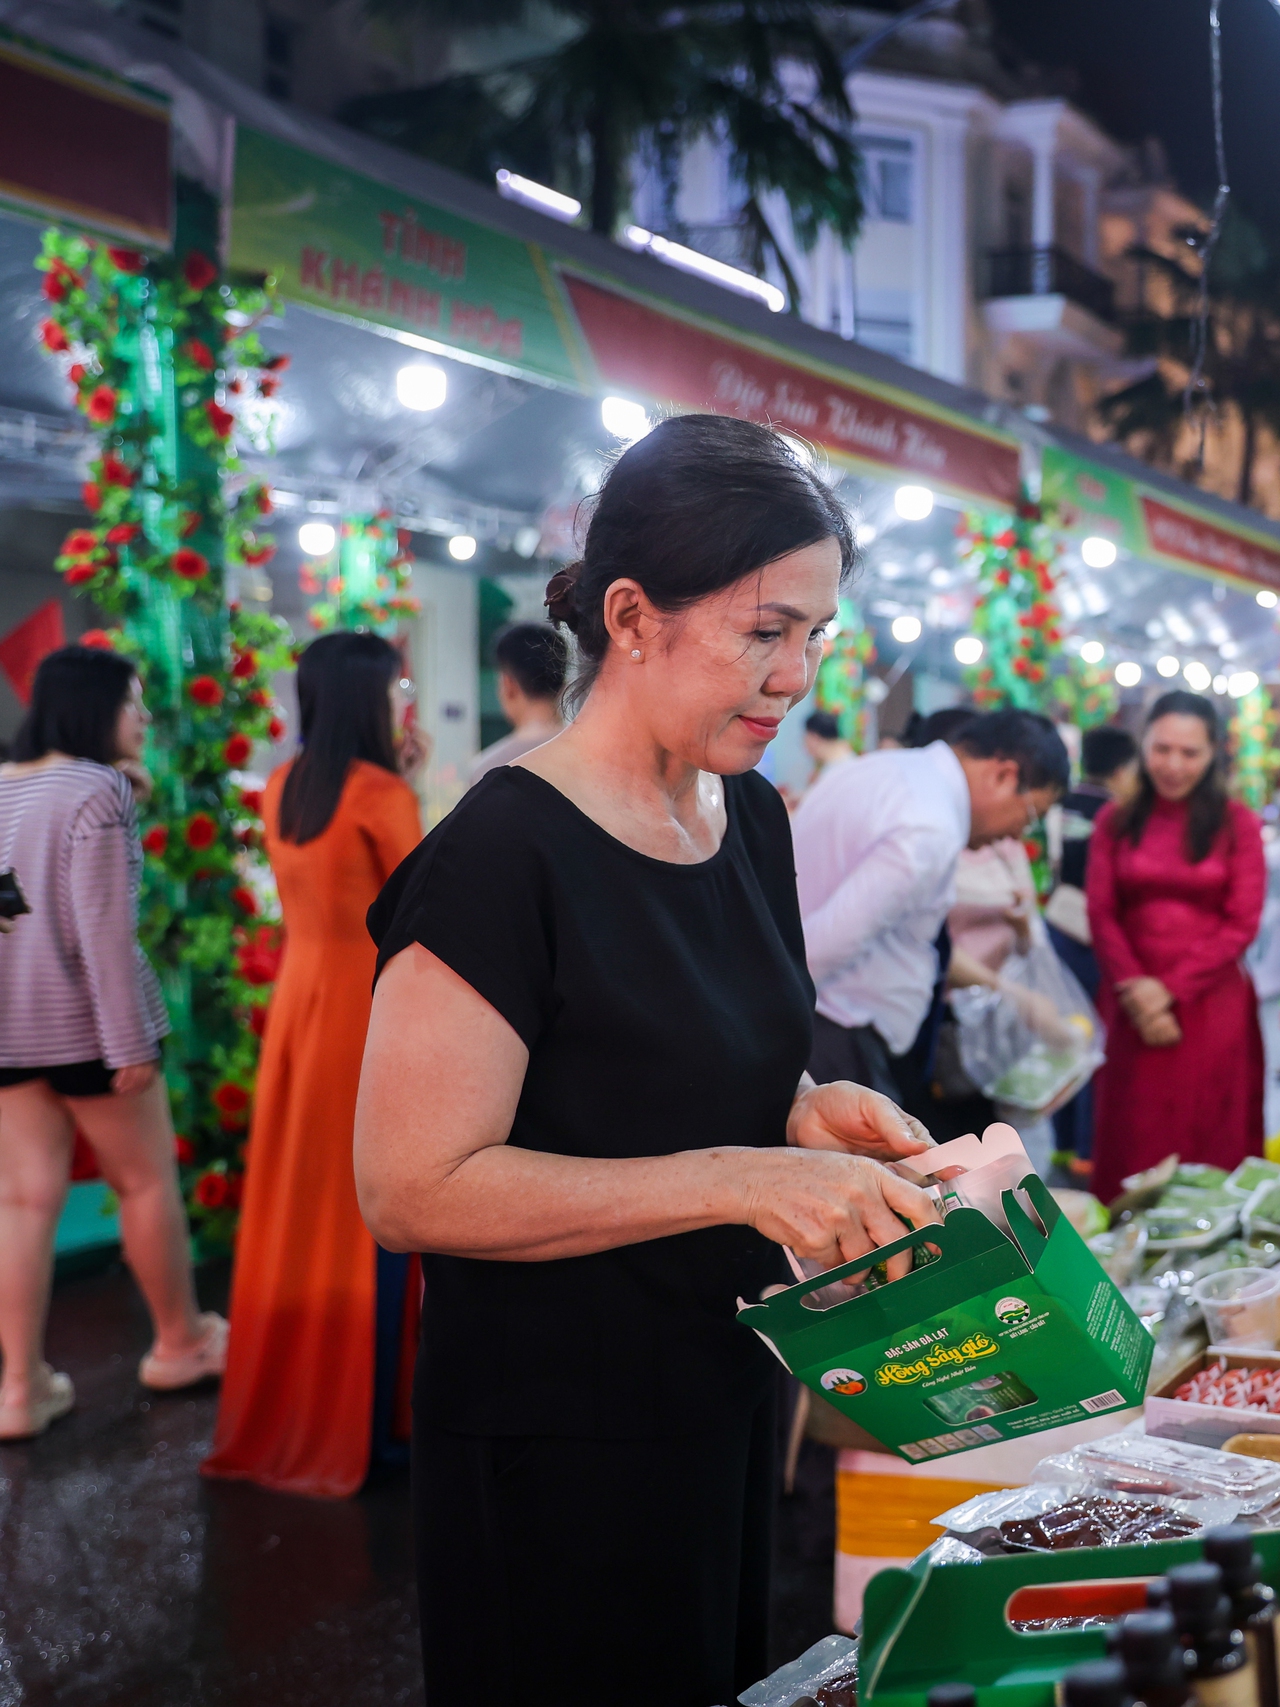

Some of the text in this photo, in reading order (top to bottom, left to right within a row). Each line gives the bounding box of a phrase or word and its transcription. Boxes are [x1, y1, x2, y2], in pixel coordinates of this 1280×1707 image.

[884, 1327, 950, 1359] ĐẶC SẢN ĐÀ LẠT
[878, 1360, 931, 1385] Hồng
